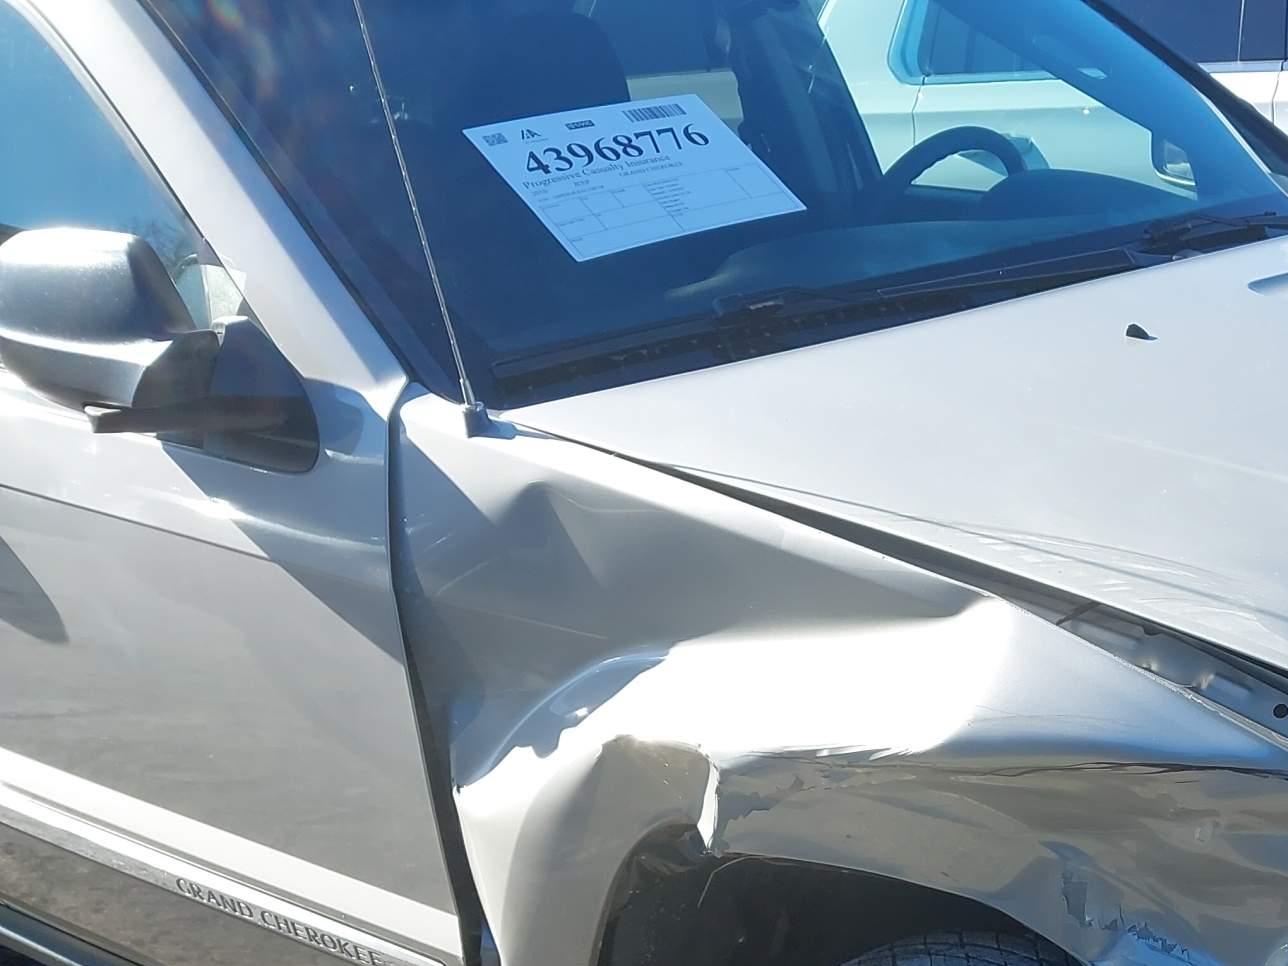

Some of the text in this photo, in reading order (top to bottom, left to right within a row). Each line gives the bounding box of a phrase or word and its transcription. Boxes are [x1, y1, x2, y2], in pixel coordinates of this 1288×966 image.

[526, 122, 710, 175] 43968776
[522, 154, 671, 190] Progressive Casualty Insurance
[175, 877, 254, 919] GRAND
